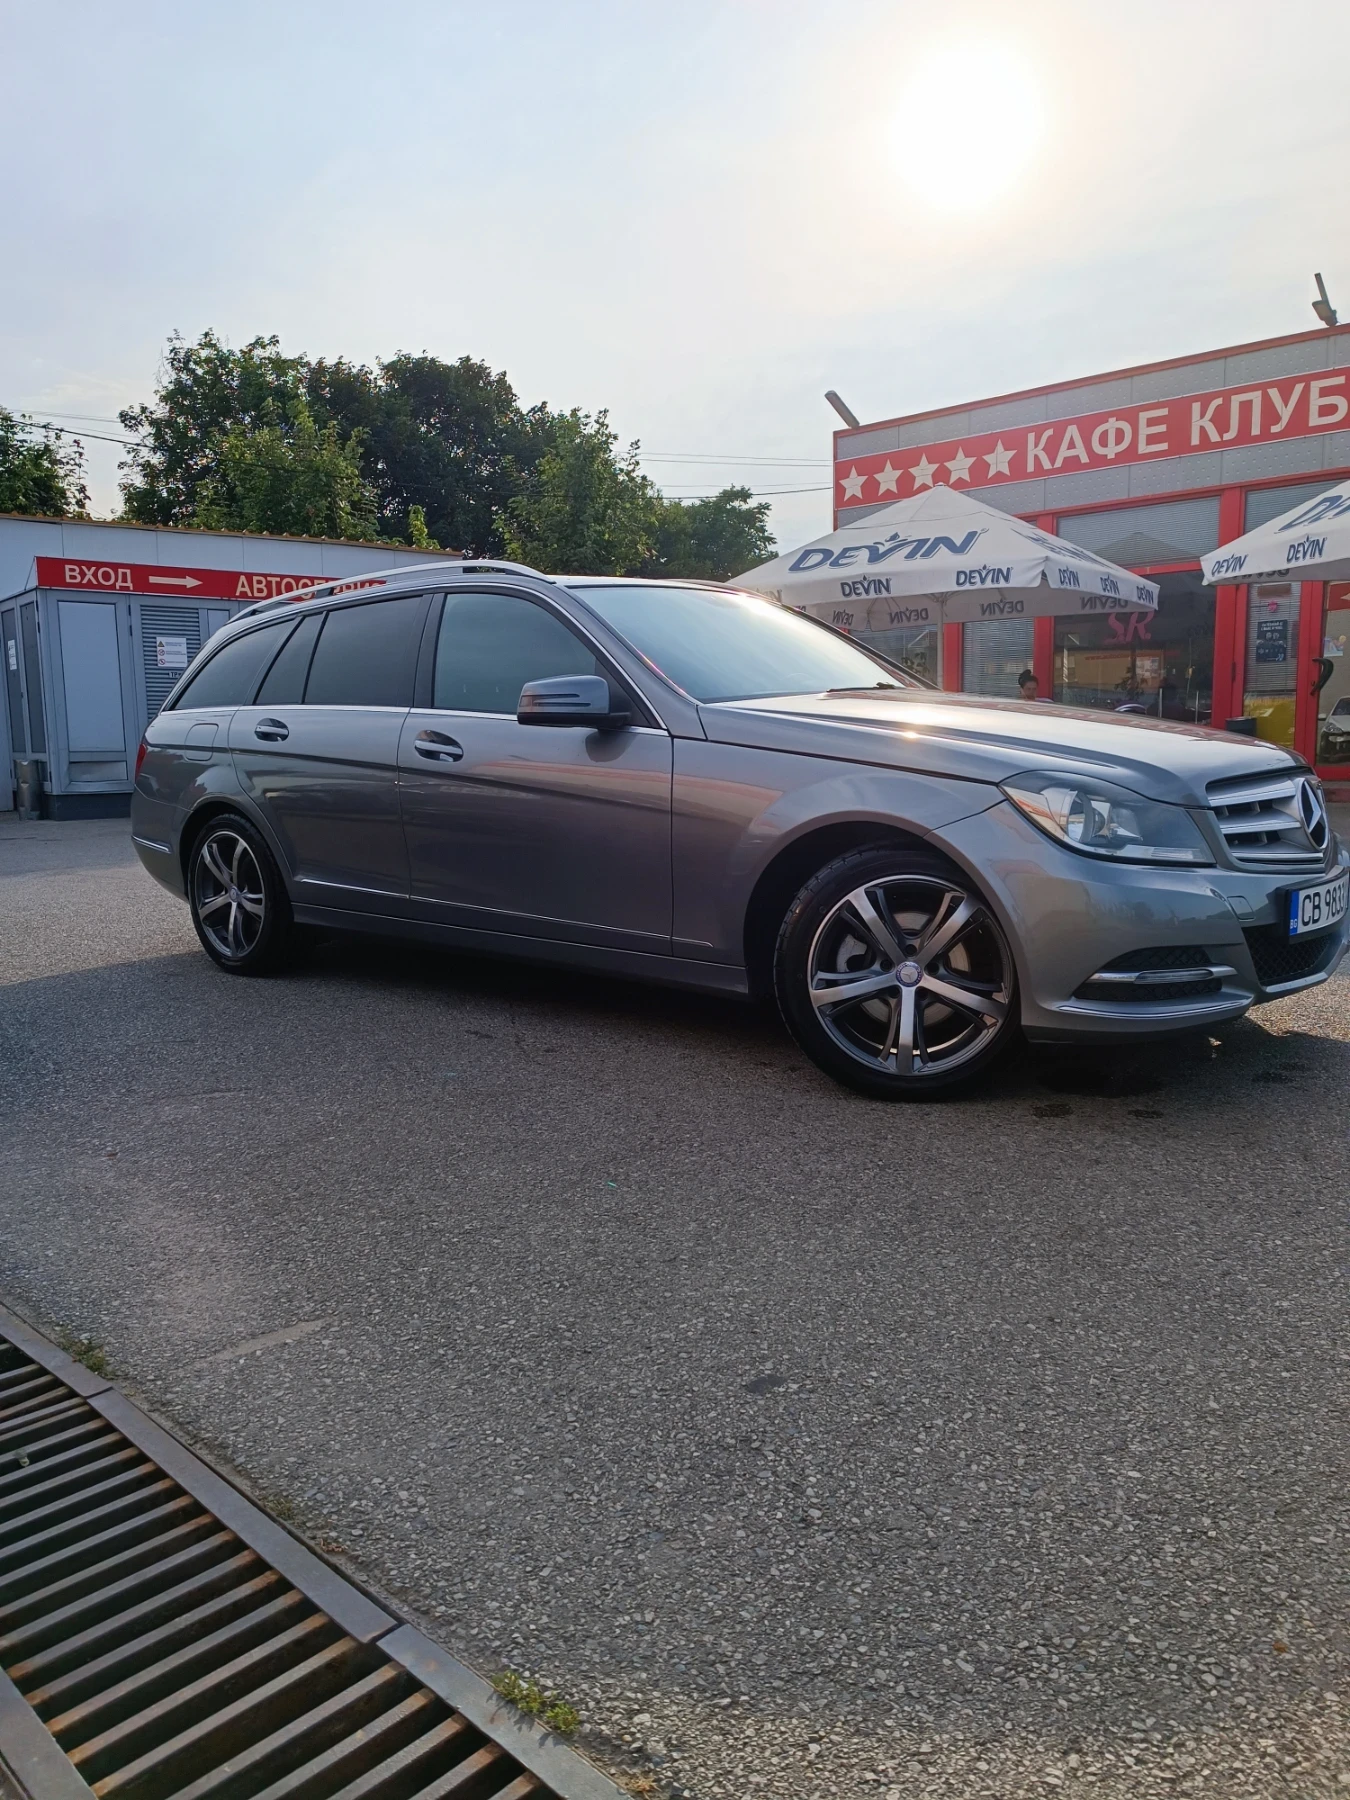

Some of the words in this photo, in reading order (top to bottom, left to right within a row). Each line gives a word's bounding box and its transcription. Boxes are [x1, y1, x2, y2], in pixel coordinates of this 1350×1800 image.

[1025, 407, 1169, 473] КАФЕ
[1190, 375, 1350, 447] КЛУБ
[788, 530, 982, 573] DEVIN
[1286, 536, 1326, 565] DEVIN
[64, 564, 134, 591] ВХОД
[956, 567, 1012, 588] DEVIN
[1211, 553, 1248, 578] DEVIN
[840, 577, 892, 598] DEVIN
[1100, 576, 1120, 596] DEVIN
[1136, 586, 1154, 605] DEVIN
[1301, 891, 1322, 927] CB
[1289, 919, 1298, 930] BG
